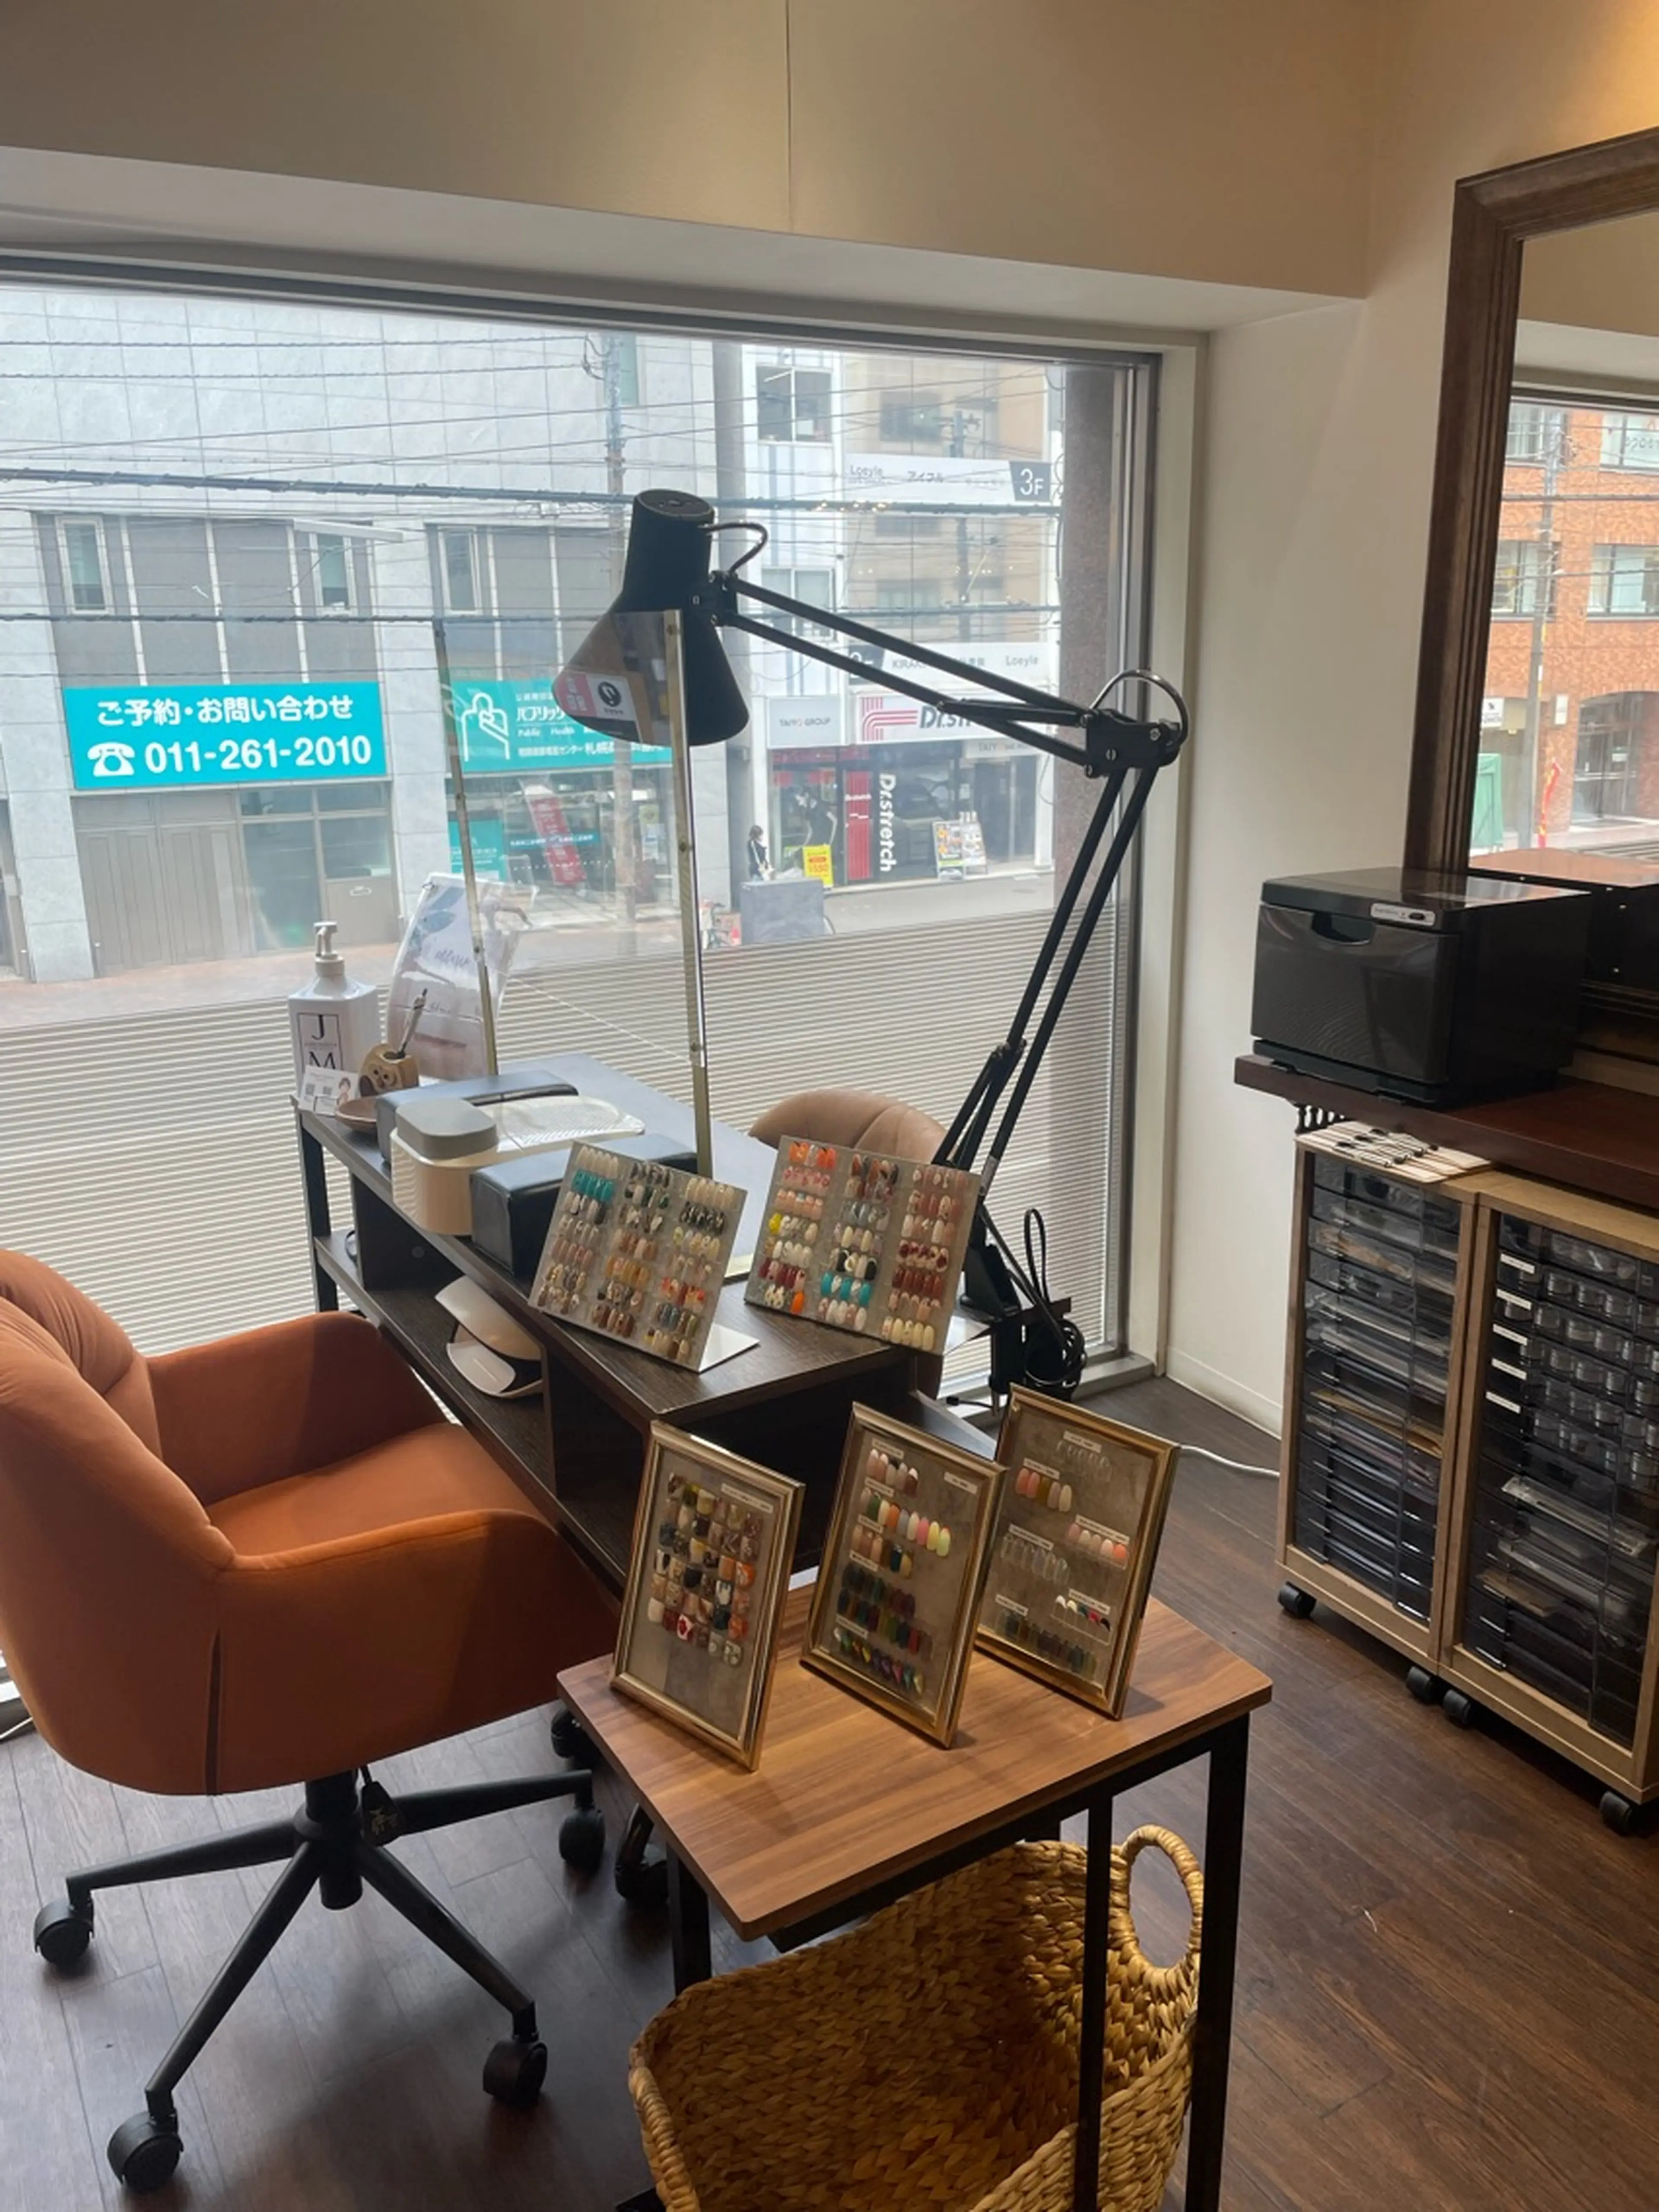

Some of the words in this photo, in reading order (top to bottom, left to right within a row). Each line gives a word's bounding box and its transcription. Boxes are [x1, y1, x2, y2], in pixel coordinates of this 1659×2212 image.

[1020, 468, 1044, 496] 3F
[97, 694, 354, 726] ご予約・お問い合わせ
[145, 735, 372, 774] 011-261-2010
[879, 773, 897, 872] Dr.stretch
